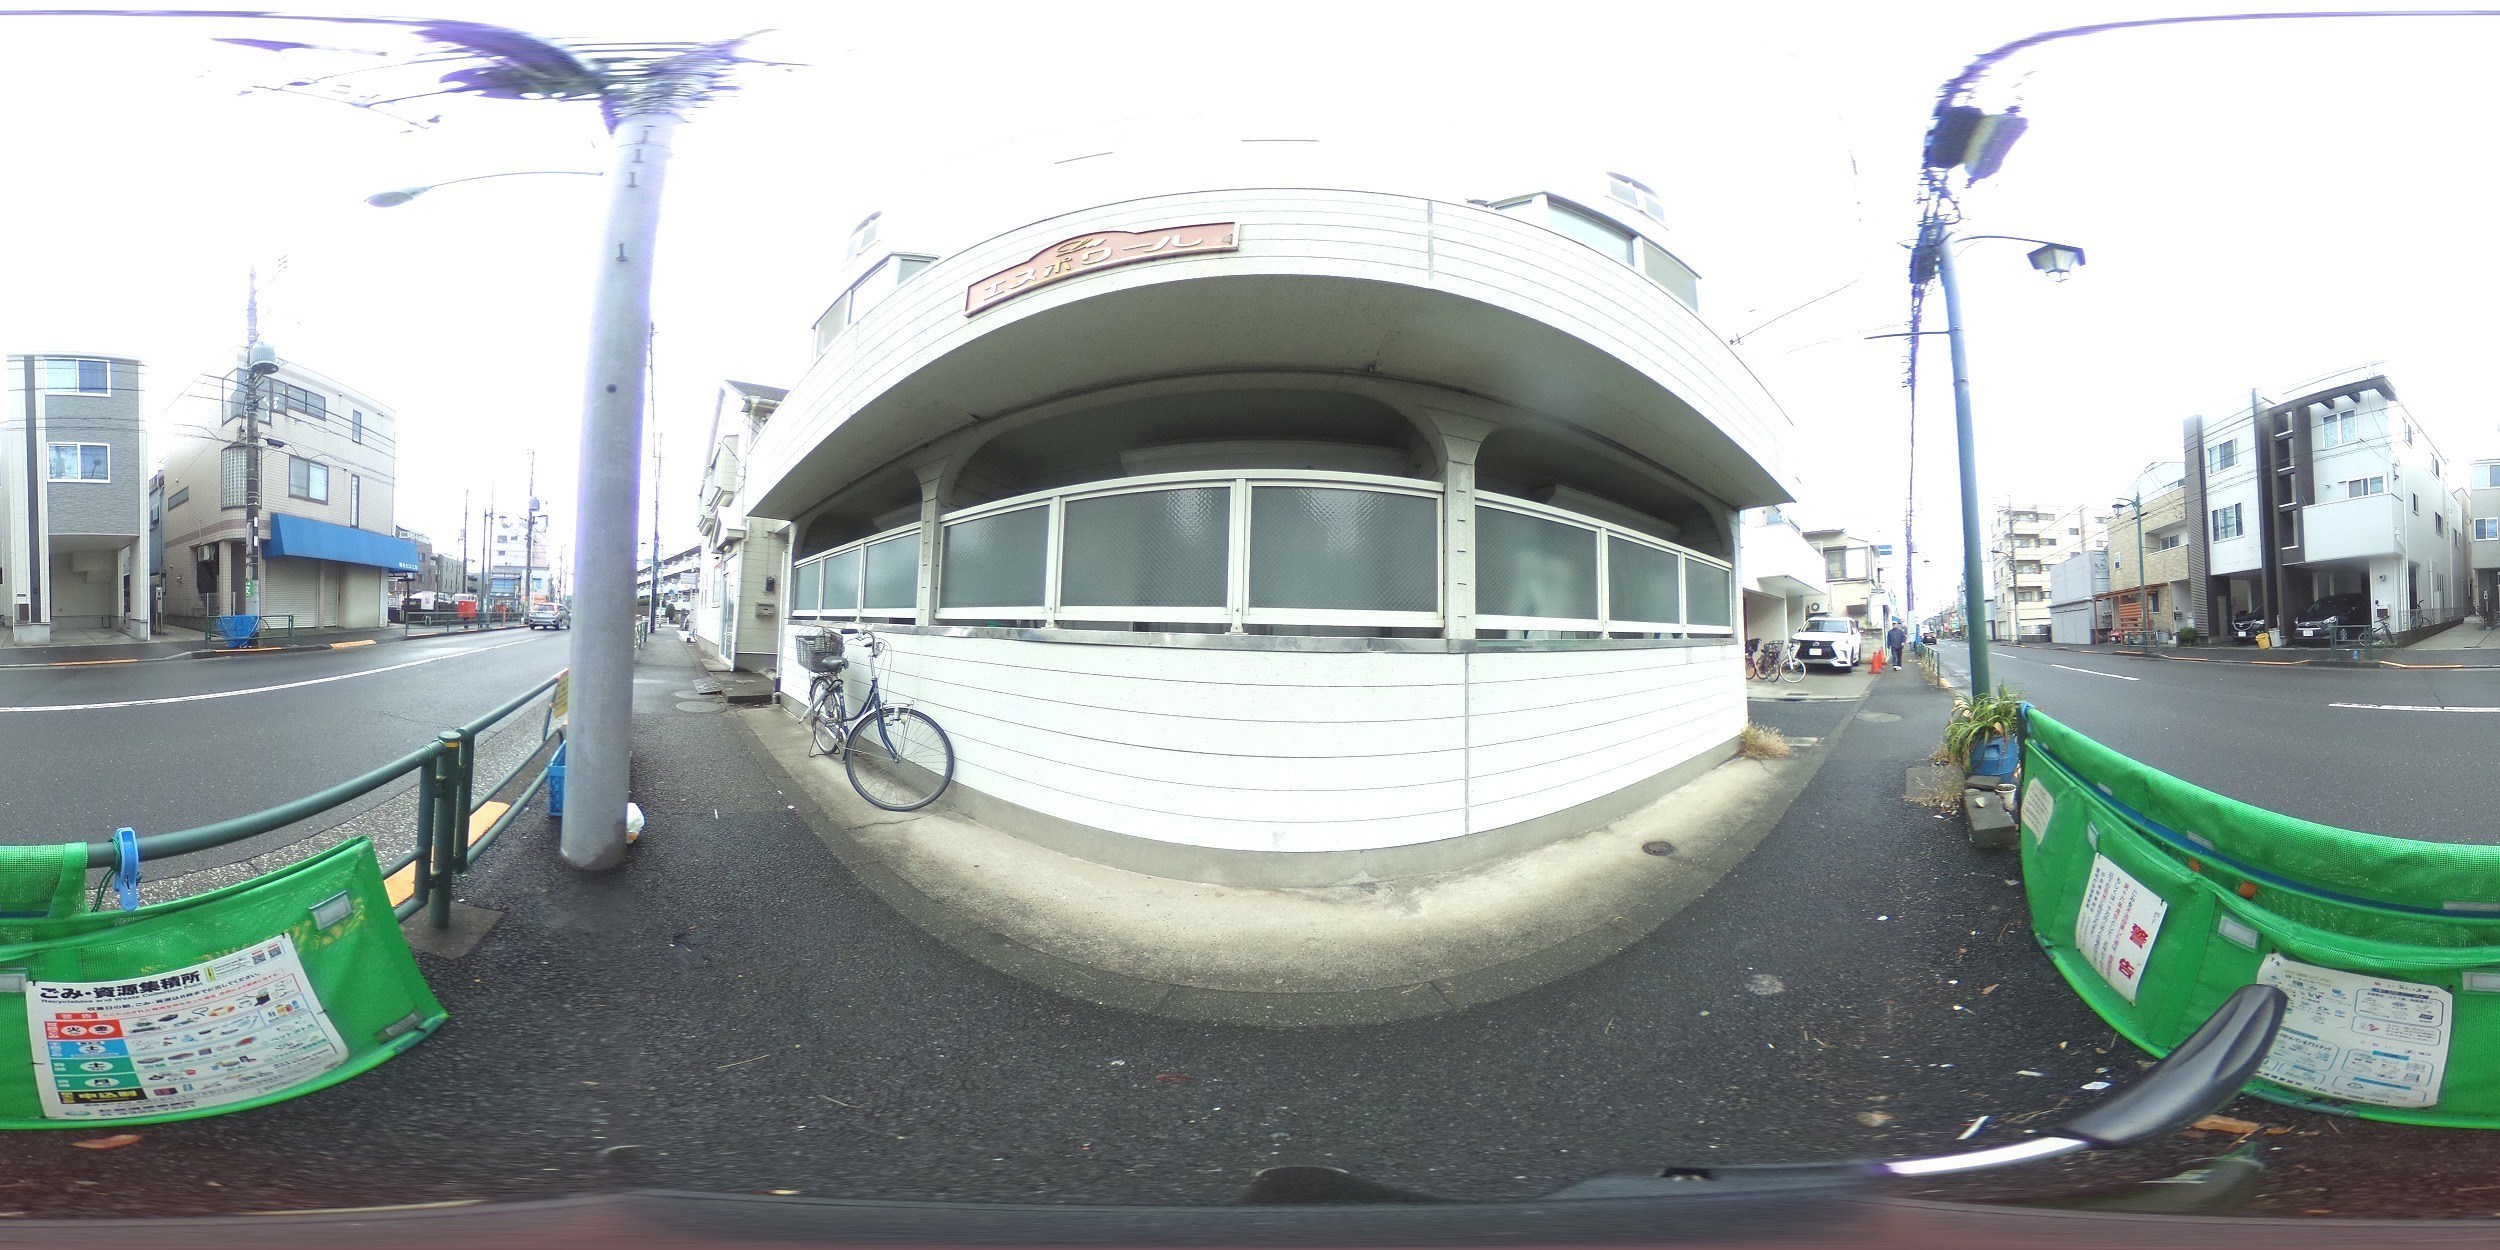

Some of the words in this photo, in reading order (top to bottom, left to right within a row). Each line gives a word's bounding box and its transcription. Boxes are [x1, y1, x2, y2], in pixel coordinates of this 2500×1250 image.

[984, 234, 1204, 301] エスポワール
[40, 970, 200, 999] ごみ・資源集積所
